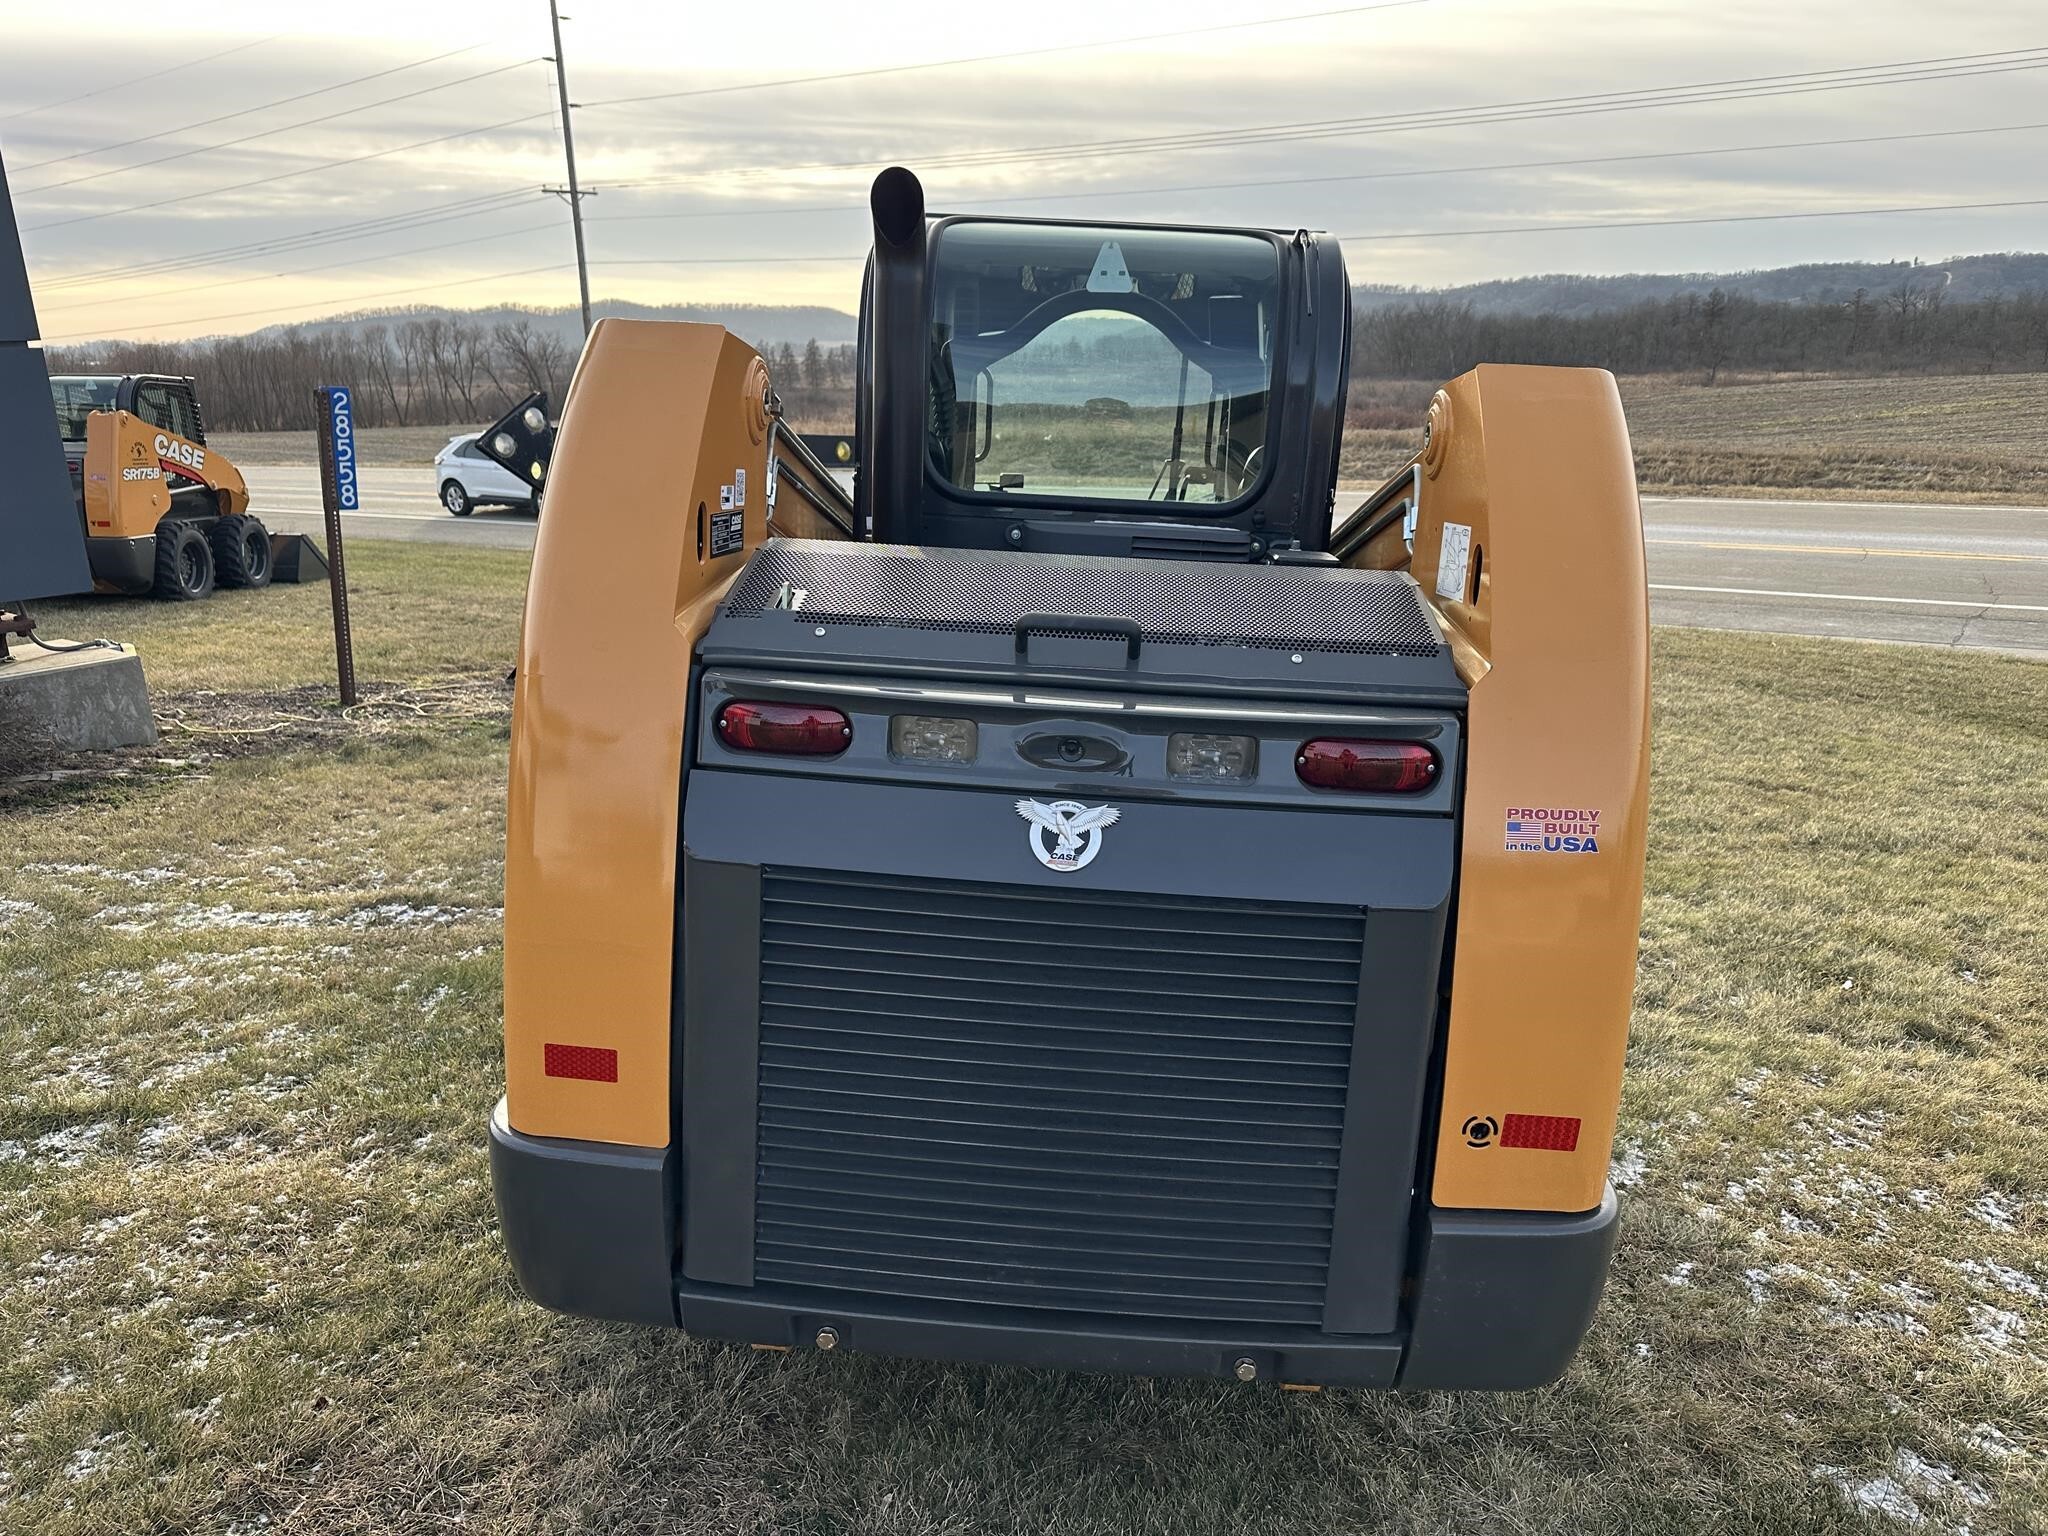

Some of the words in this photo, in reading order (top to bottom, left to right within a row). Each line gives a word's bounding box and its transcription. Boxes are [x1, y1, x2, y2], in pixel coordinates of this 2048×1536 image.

[154, 433, 205, 471] CASE
[333, 392, 355, 506] 28558
[122, 467, 160, 481] SR175B
[1506, 808, 1601, 822] PROUDLY
[1543, 822, 1600, 835] BUILT
[1505, 842, 1517, 850] in
[1519, 842, 1542, 851] the
[1543, 836, 1599, 853] USA
[1050, 852, 1080, 861] CASE
